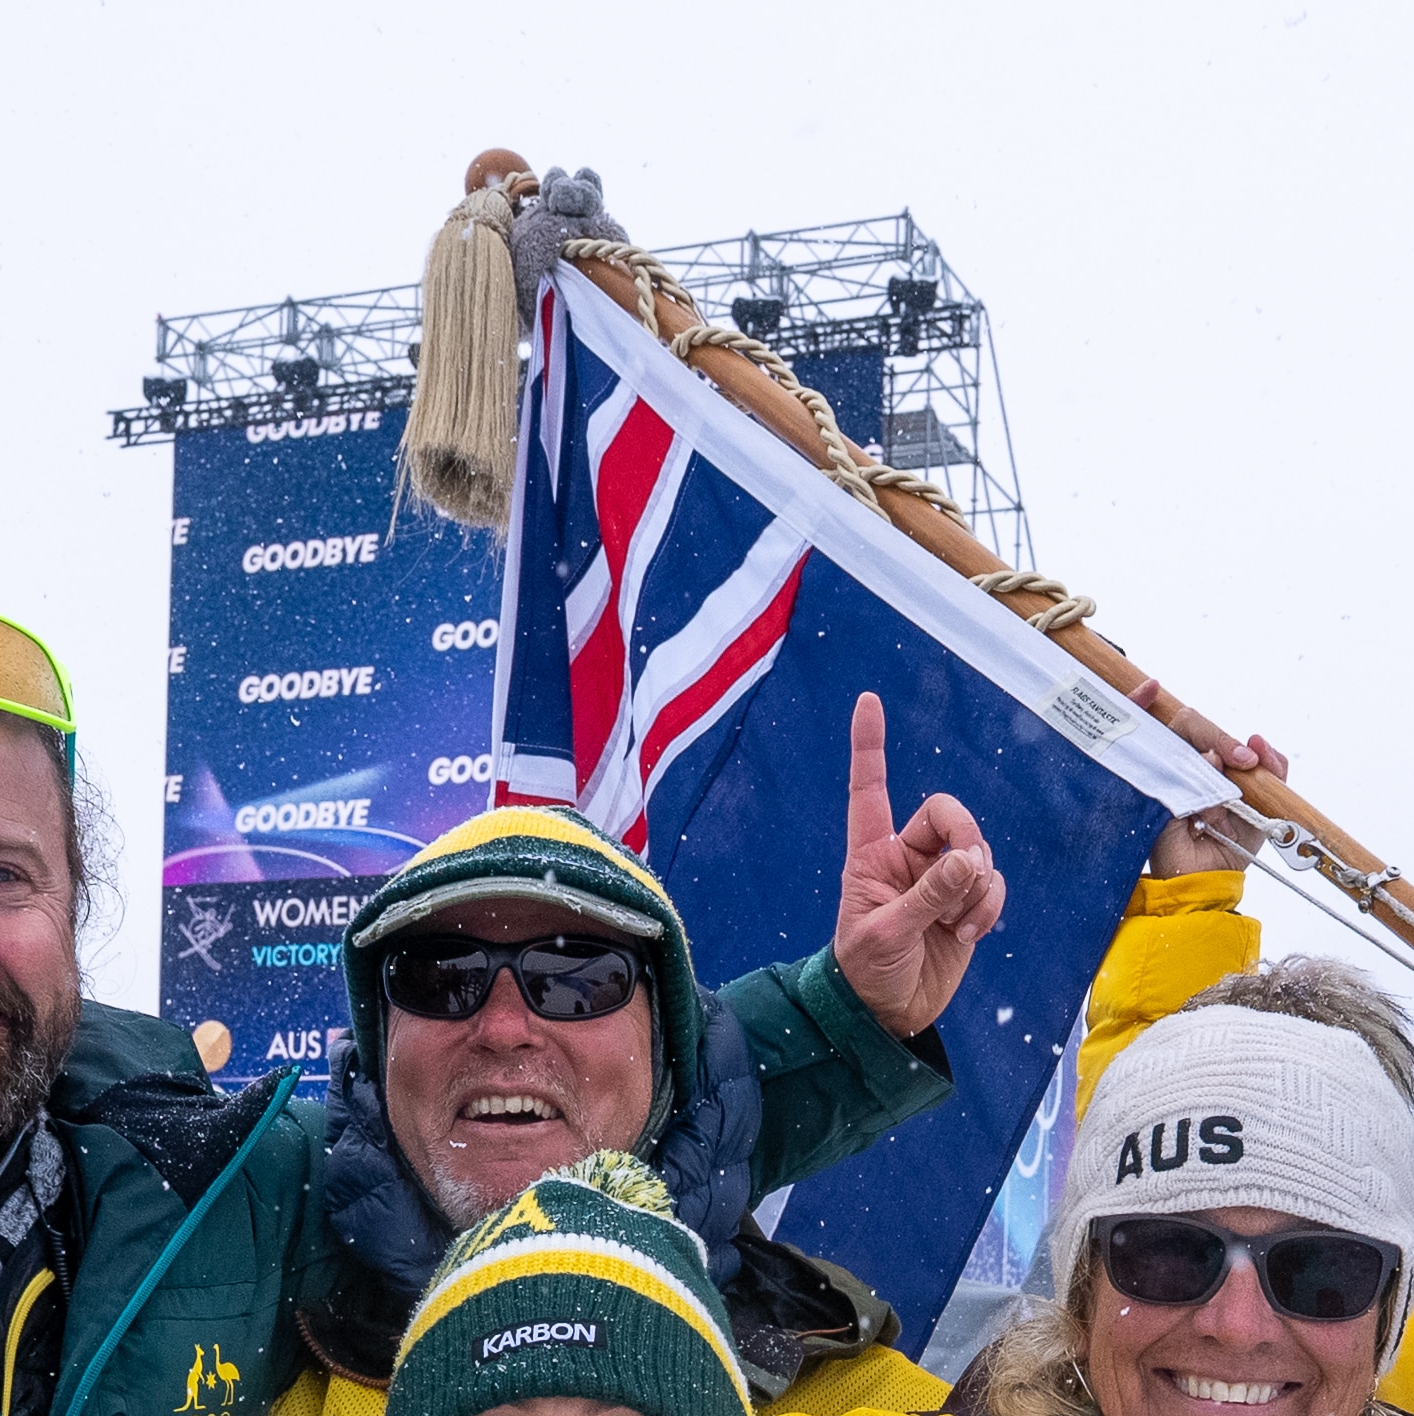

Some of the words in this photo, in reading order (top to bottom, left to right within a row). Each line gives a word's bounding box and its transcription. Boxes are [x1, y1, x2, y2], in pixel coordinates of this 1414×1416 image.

[242, 532, 380, 575] GOODBYE
[238, 665, 375, 704] GOODBYE
[235, 798, 372, 834] GOODBYE
[252, 942, 342, 968] VICTORY
[265, 1029, 323, 1061] AUS
[1115, 1114, 1245, 1186] AUS
[482, 1321, 597, 1358] KARBON
